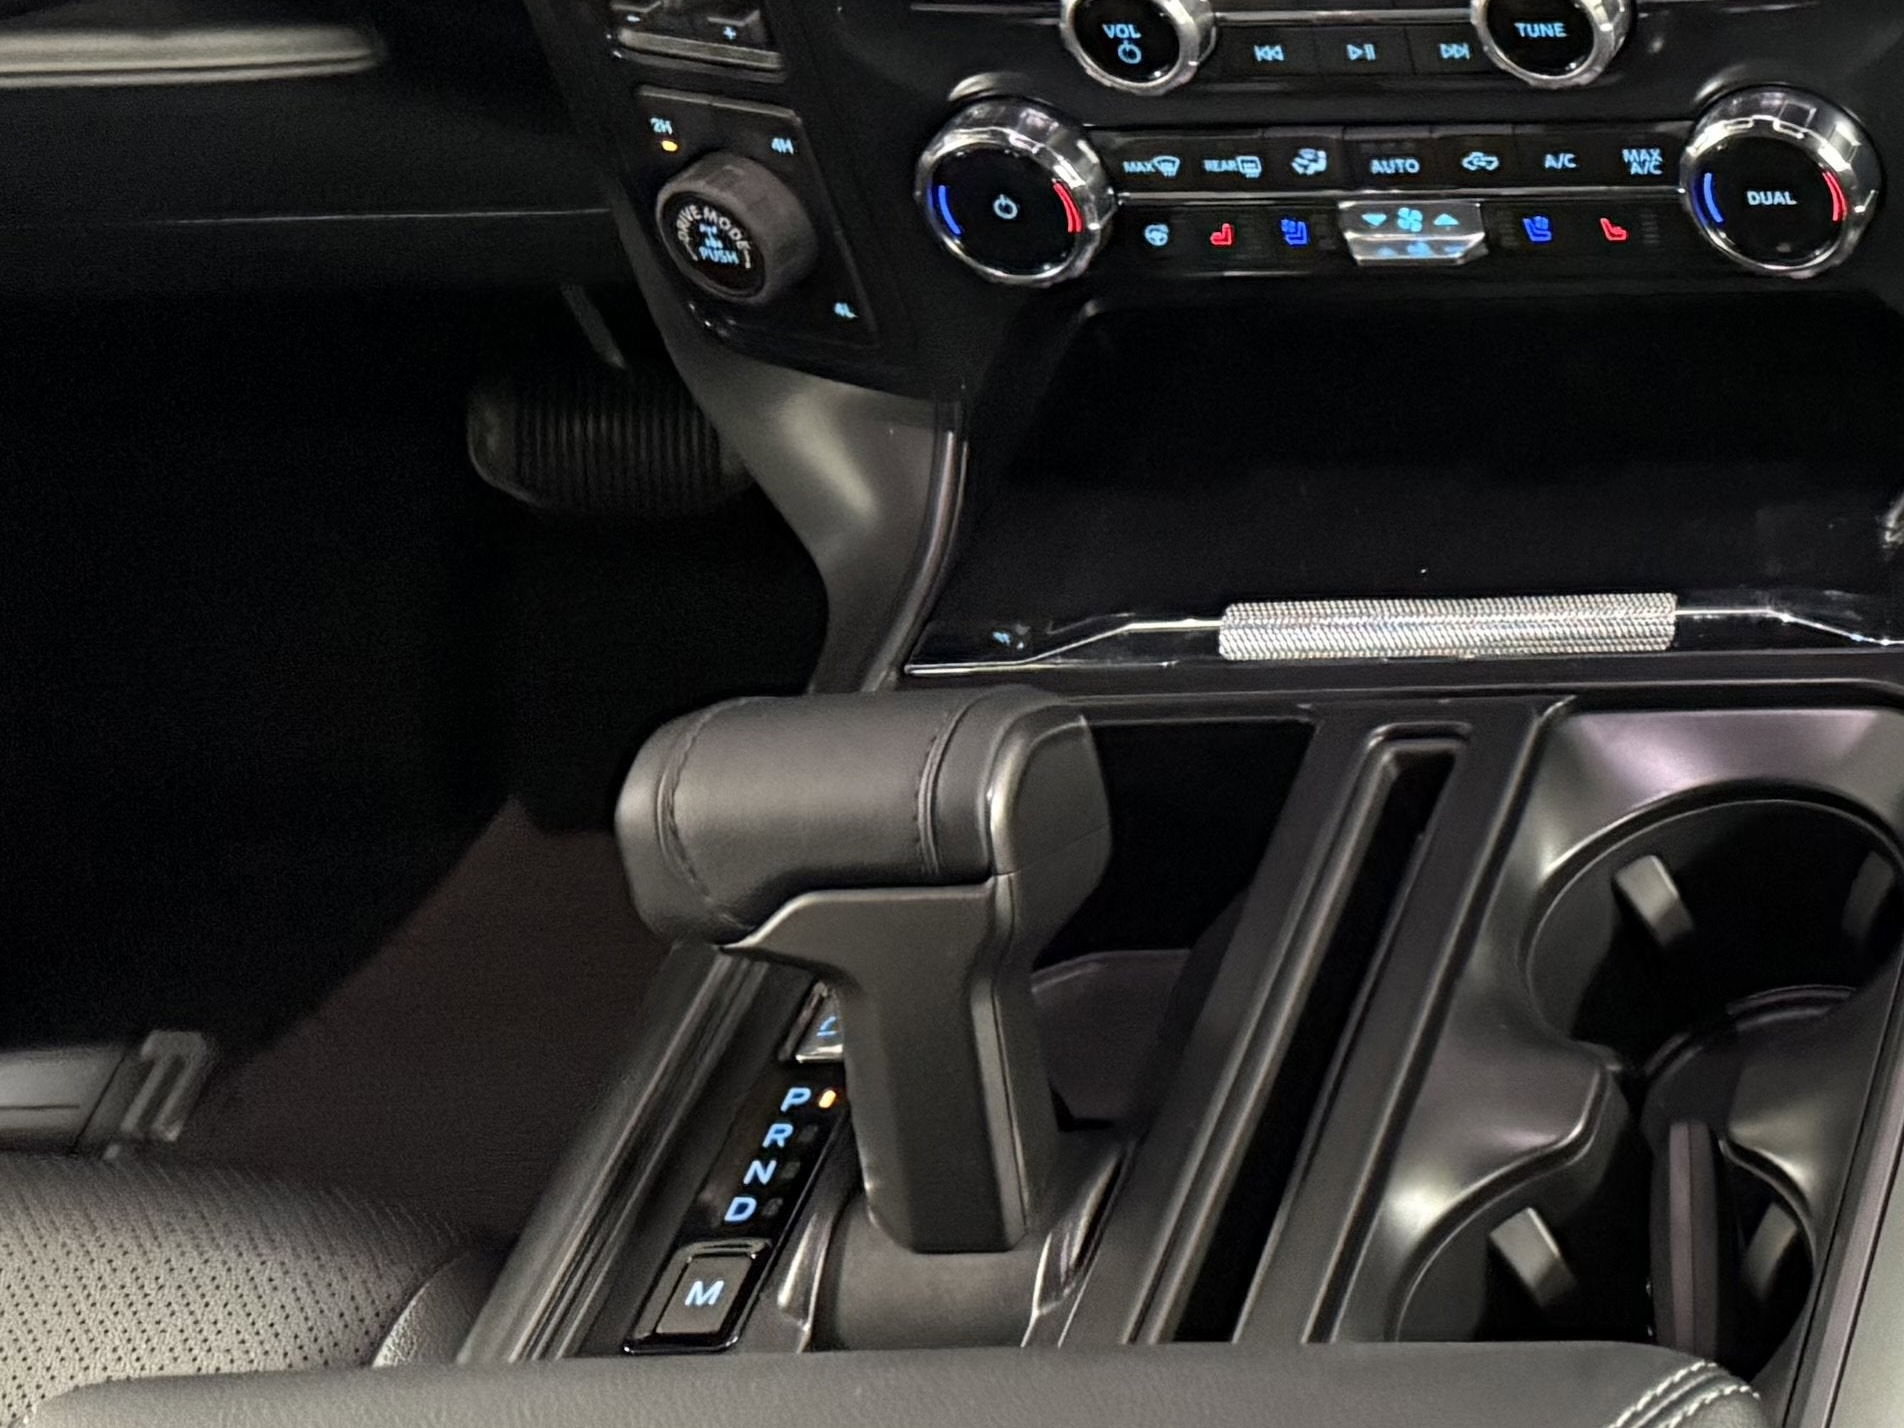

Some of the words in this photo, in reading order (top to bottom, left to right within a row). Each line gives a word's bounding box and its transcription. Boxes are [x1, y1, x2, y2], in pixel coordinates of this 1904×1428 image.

[1103, 22, 1141, 40] VOL
[1515, 22, 1567, 39] TUNE
[650, 117, 672, 135] 2H
[771, 137, 794, 154] 4H
[1544, 152, 1576, 169] A/C
[1622, 148, 1663, 164] MAX
[1123, 160, 1155, 173] MAX
[1370, 158, 1420, 175] AUTO
[1629, 160, 1663, 175] A/C
[1747, 190, 1797, 206] DUAL
[676, 204, 702, 244] DRIVE
[703, 206, 751, 250] MODE
[698, 246, 740, 265] PUSH
[780, 1087, 811, 1113] P
[763, 1122, 793, 1148] R
[743, 1159, 776, 1185] N
[724, 1196, 756, 1222] D
[684, 1280, 724, 1306] M
